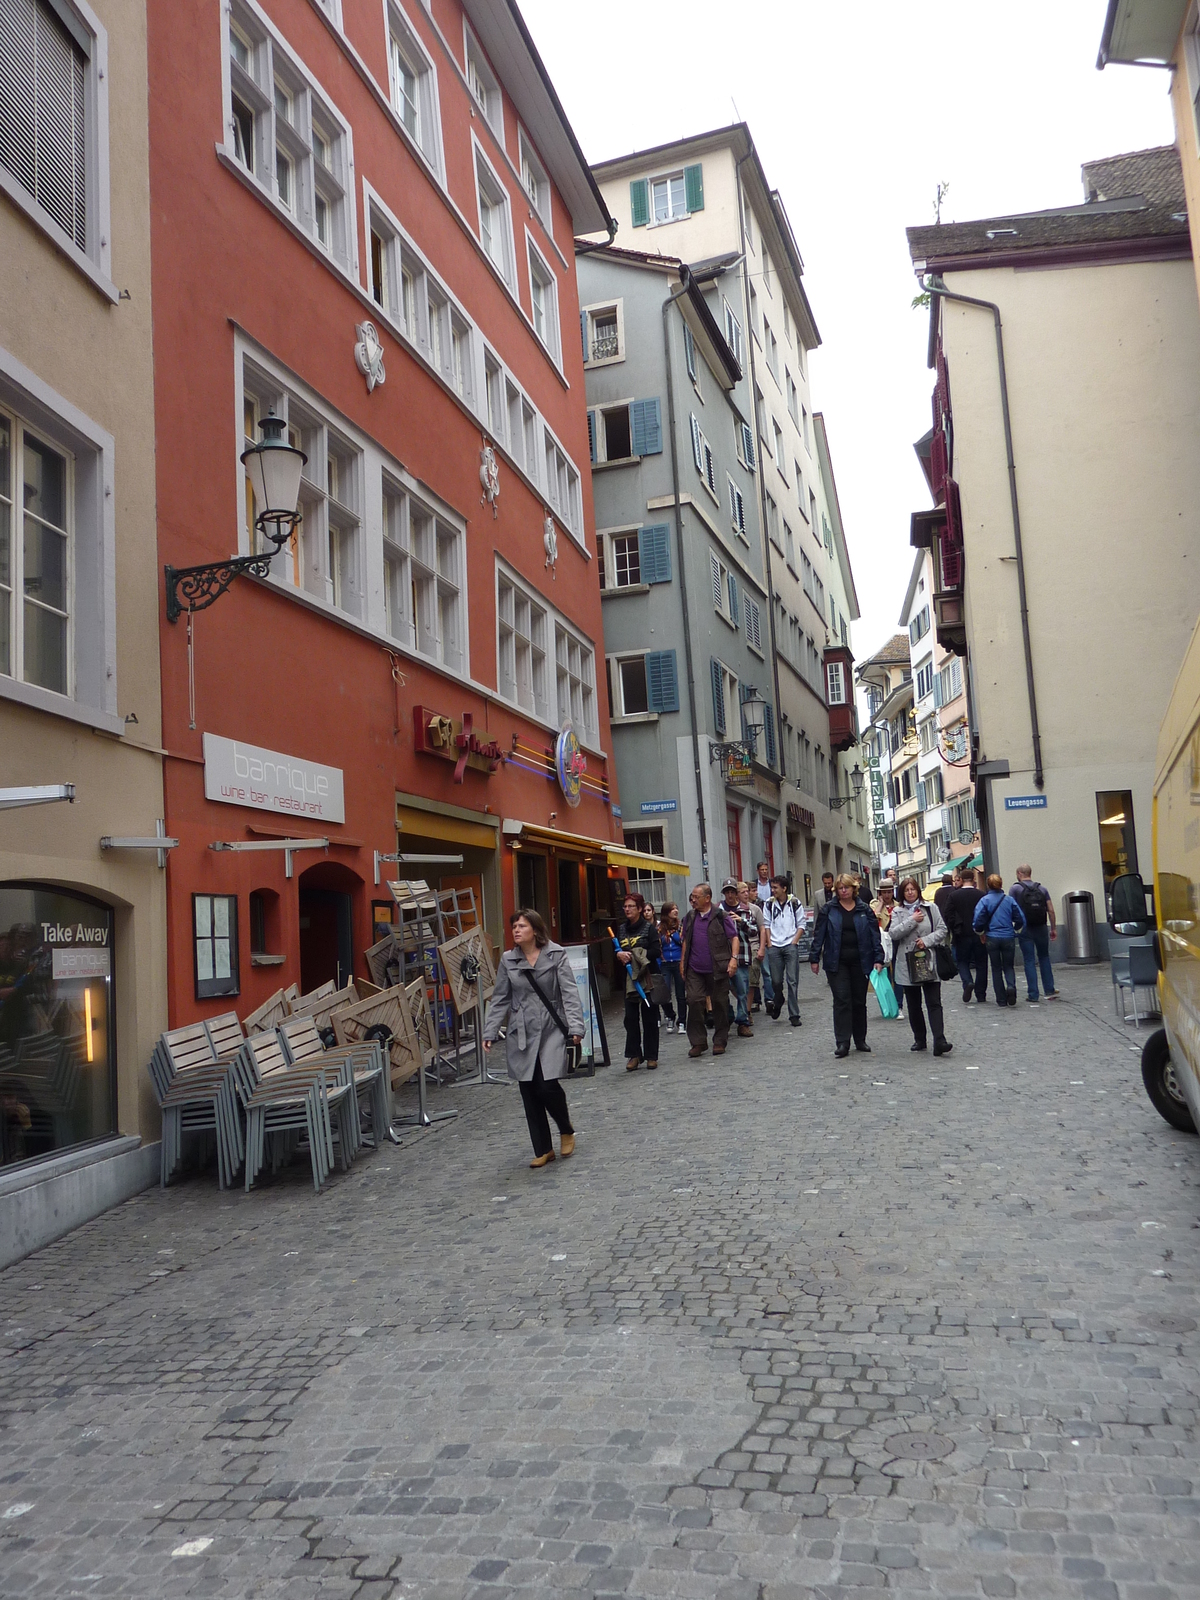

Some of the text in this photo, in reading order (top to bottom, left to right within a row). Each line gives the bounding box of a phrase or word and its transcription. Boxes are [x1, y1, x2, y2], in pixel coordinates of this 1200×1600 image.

[233, 742, 328, 802] barrique
[220, 784, 323, 815] wine bar restaurant
[641, 802, 676, 812] Metzgergasse
[869, 759, 886, 838] CINEMA
[1007, 799, 1044, 808] Leuengasse
[40, 922, 109, 946] Take Away
